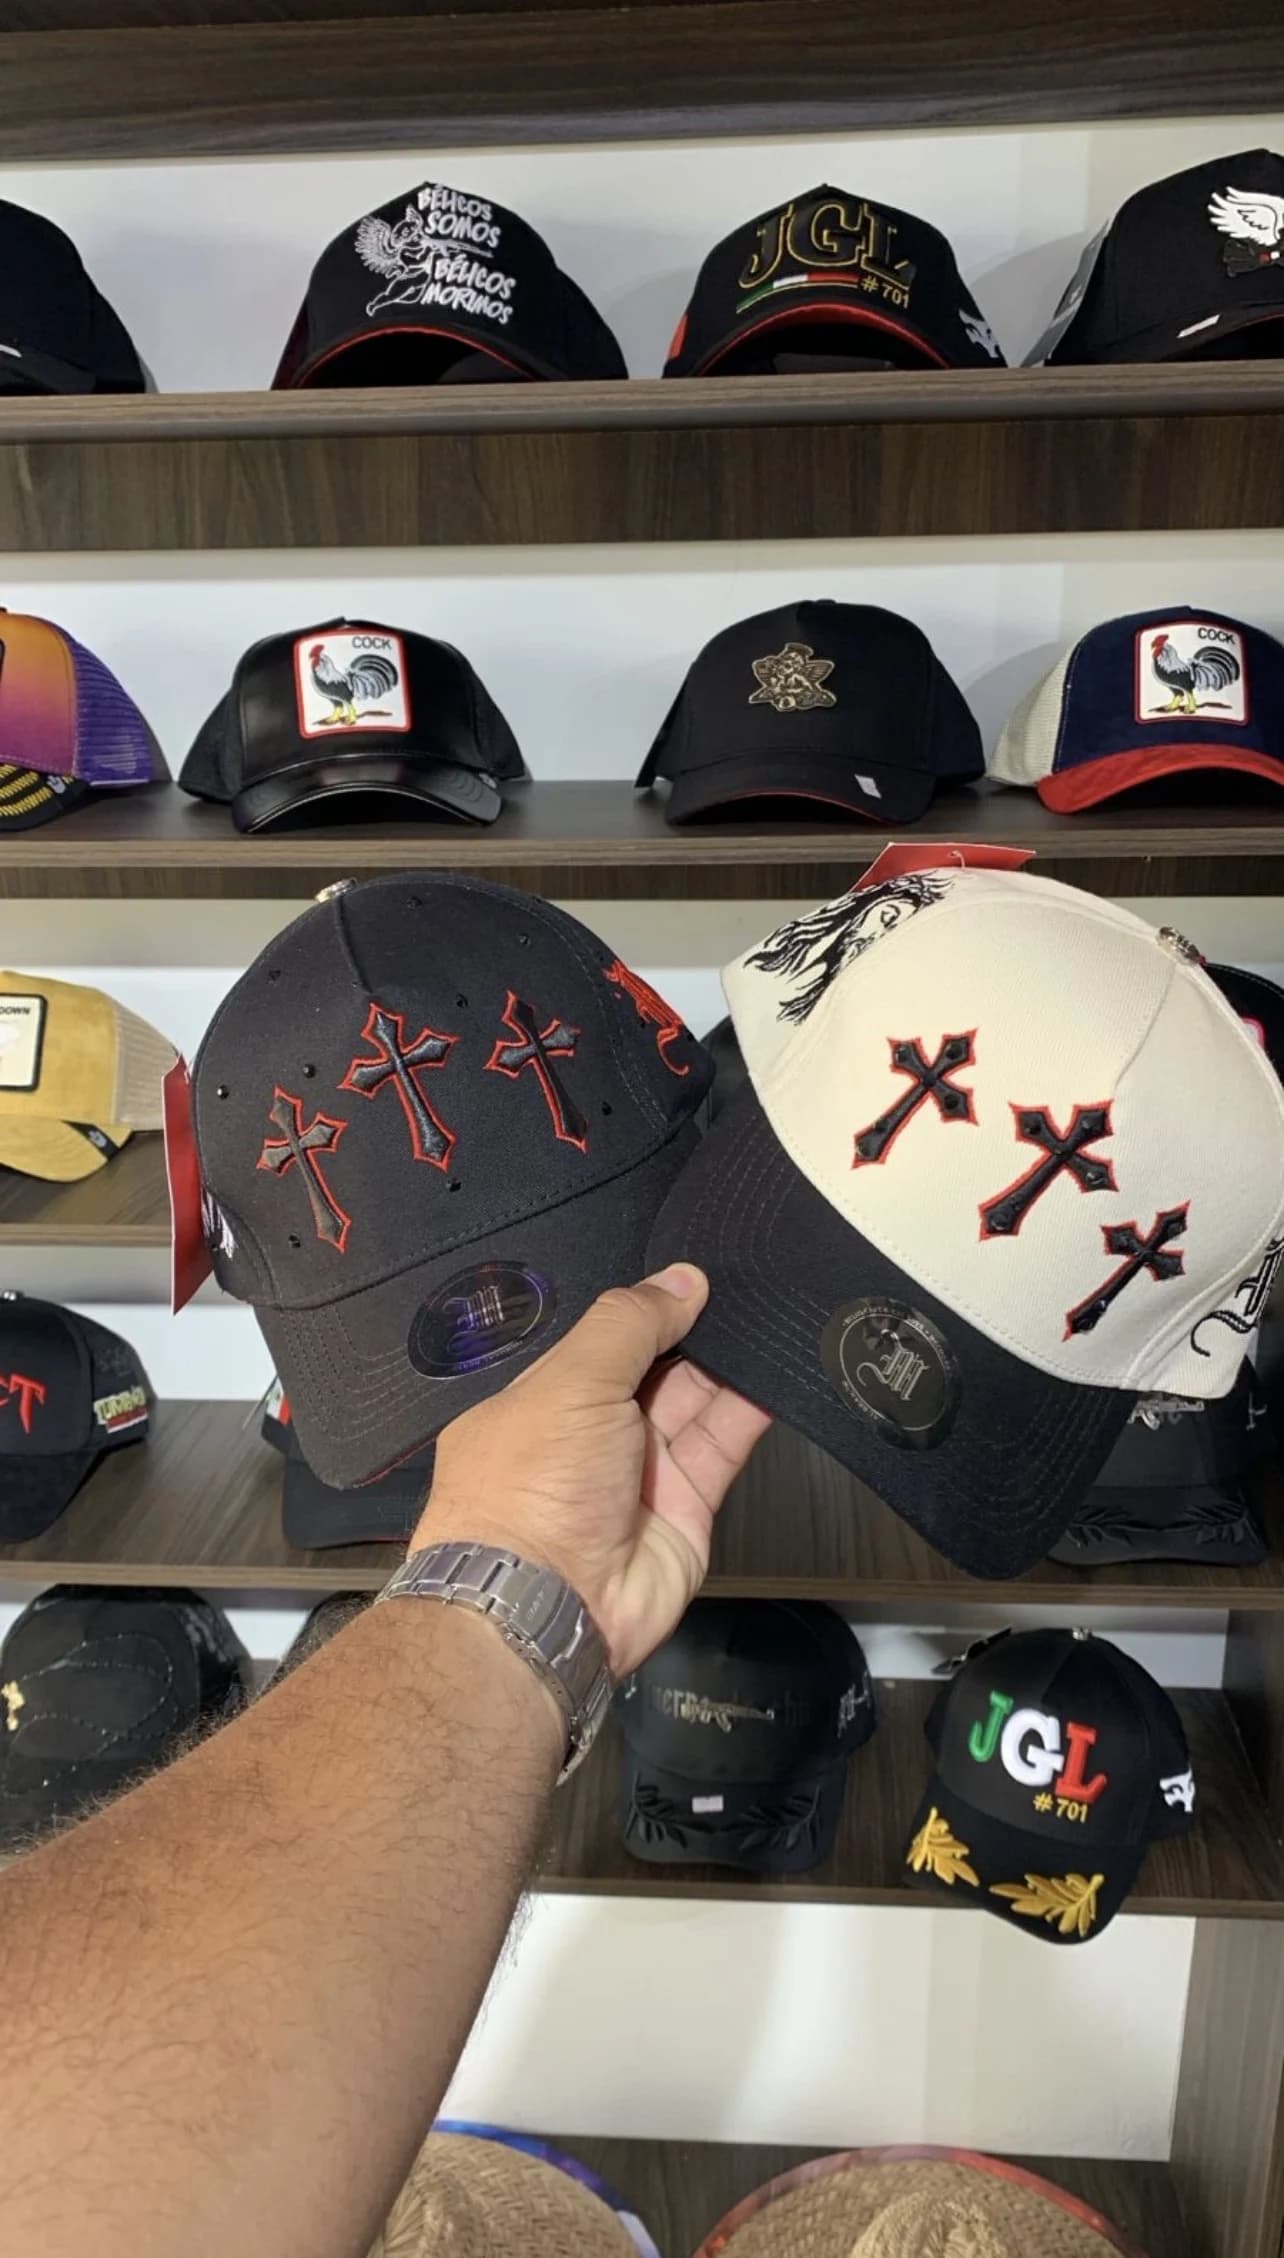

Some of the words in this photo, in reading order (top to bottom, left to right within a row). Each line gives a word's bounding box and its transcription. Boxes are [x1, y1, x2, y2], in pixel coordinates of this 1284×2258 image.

[424, 211, 501, 248] SOMOS
[738, 202, 917, 290] JGL
[434, 253, 517, 300] BÉLICOS
[352, 636, 392, 650] COCK
[1198, 627, 1235, 645] COCK
[968, 1690, 1108, 1804] JGL
